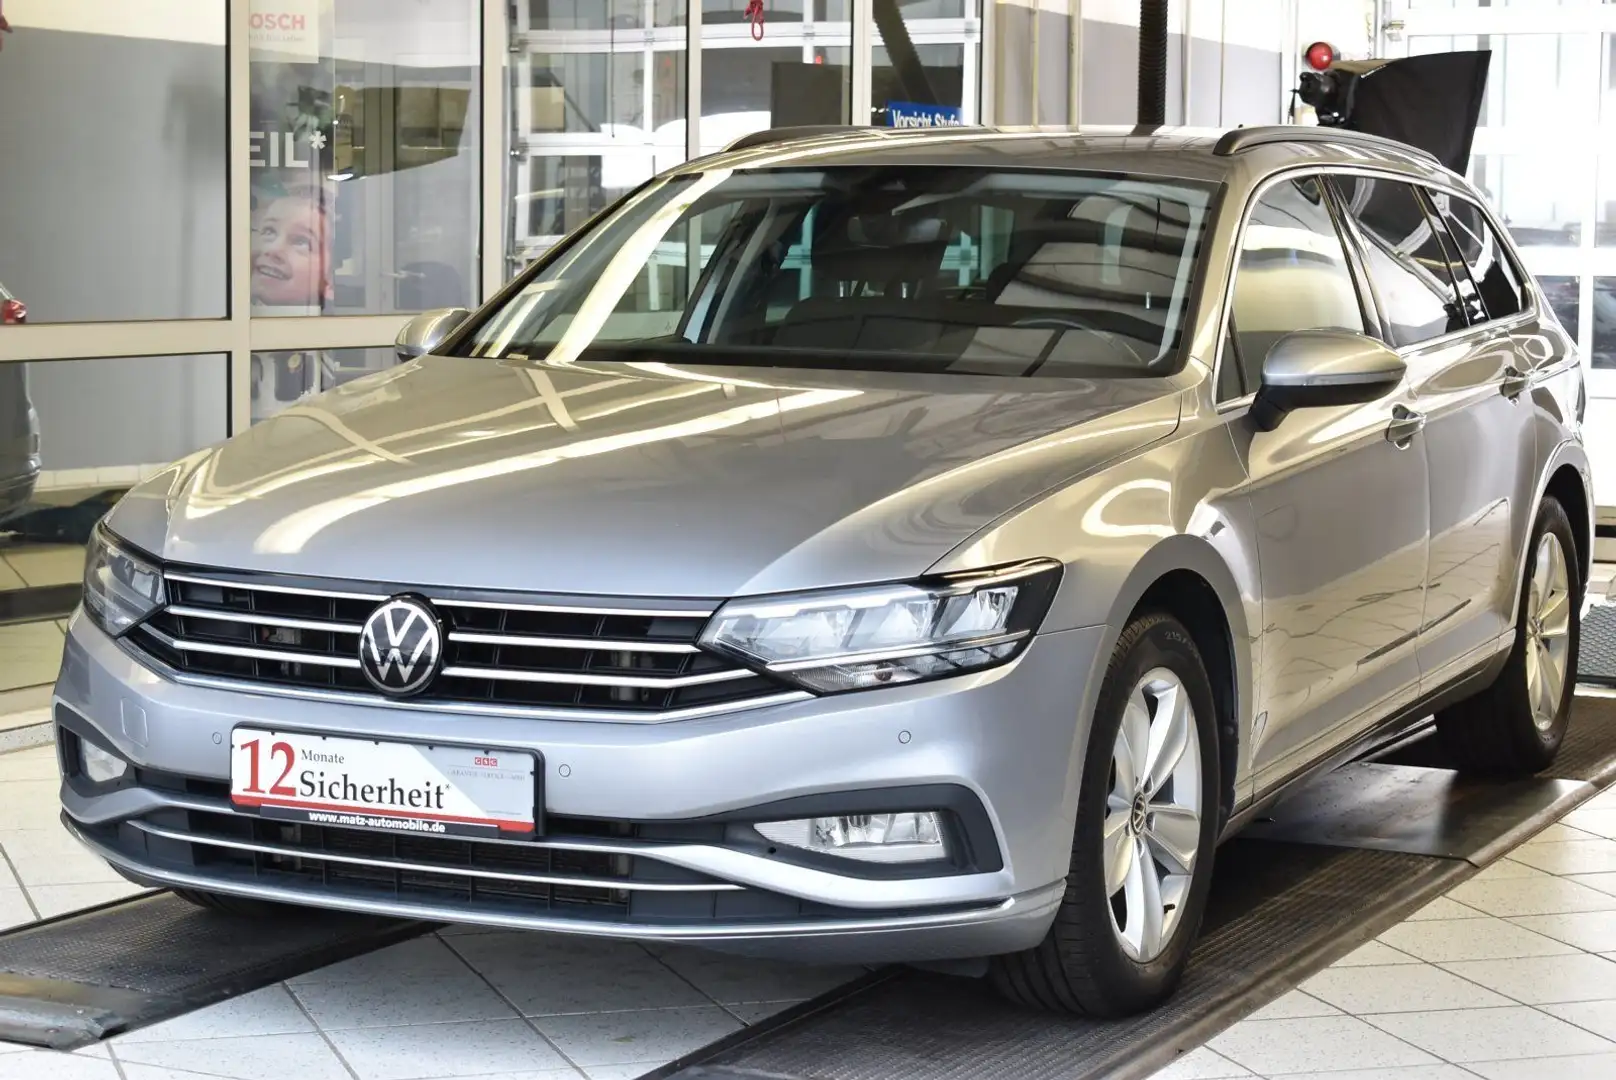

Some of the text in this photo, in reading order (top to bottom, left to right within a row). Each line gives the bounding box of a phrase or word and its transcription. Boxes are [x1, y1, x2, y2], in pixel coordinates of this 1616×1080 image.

[249, 13, 305, 30] OSCH
[892, 109, 932, 128] Vorsicht
[301, 748, 345, 765] Monate
[240, 738, 297, 797] 12
[309, 812, 446, 833] www.matz-automobile.de
